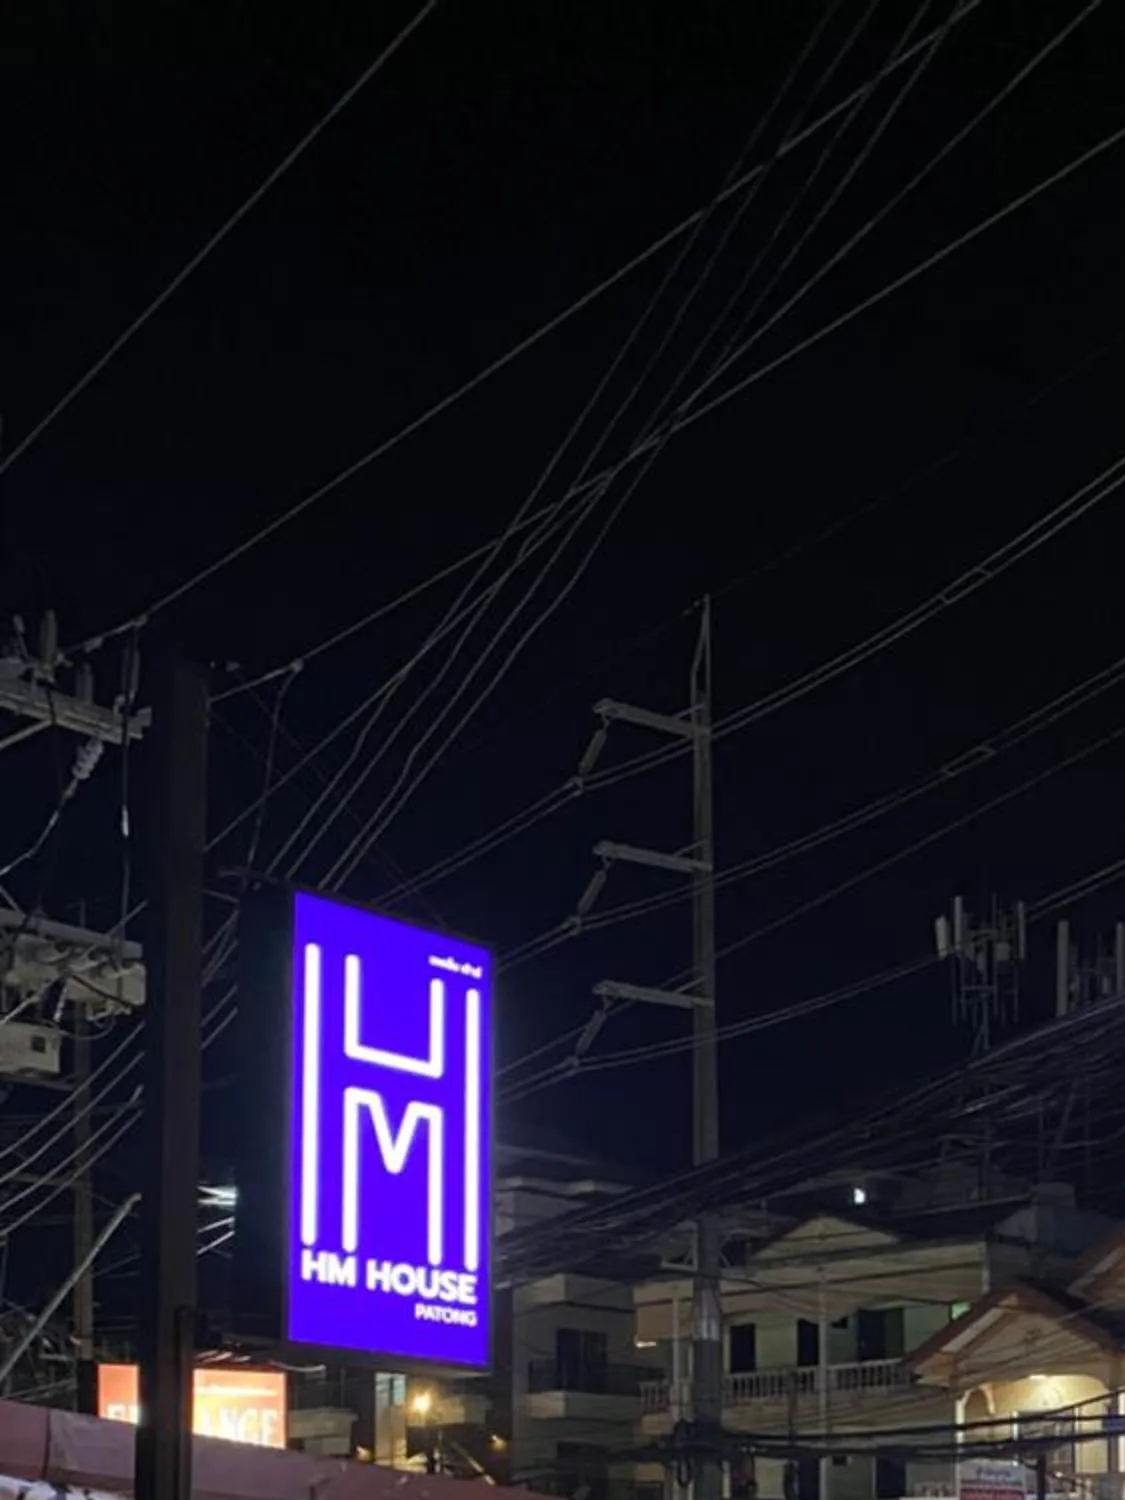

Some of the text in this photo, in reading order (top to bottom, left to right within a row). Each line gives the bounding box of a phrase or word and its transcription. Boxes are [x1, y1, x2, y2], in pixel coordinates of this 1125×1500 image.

[302, 1250, 478, 1305] HM HOUSE
[414, 1303, 478, 1328] PATONG
